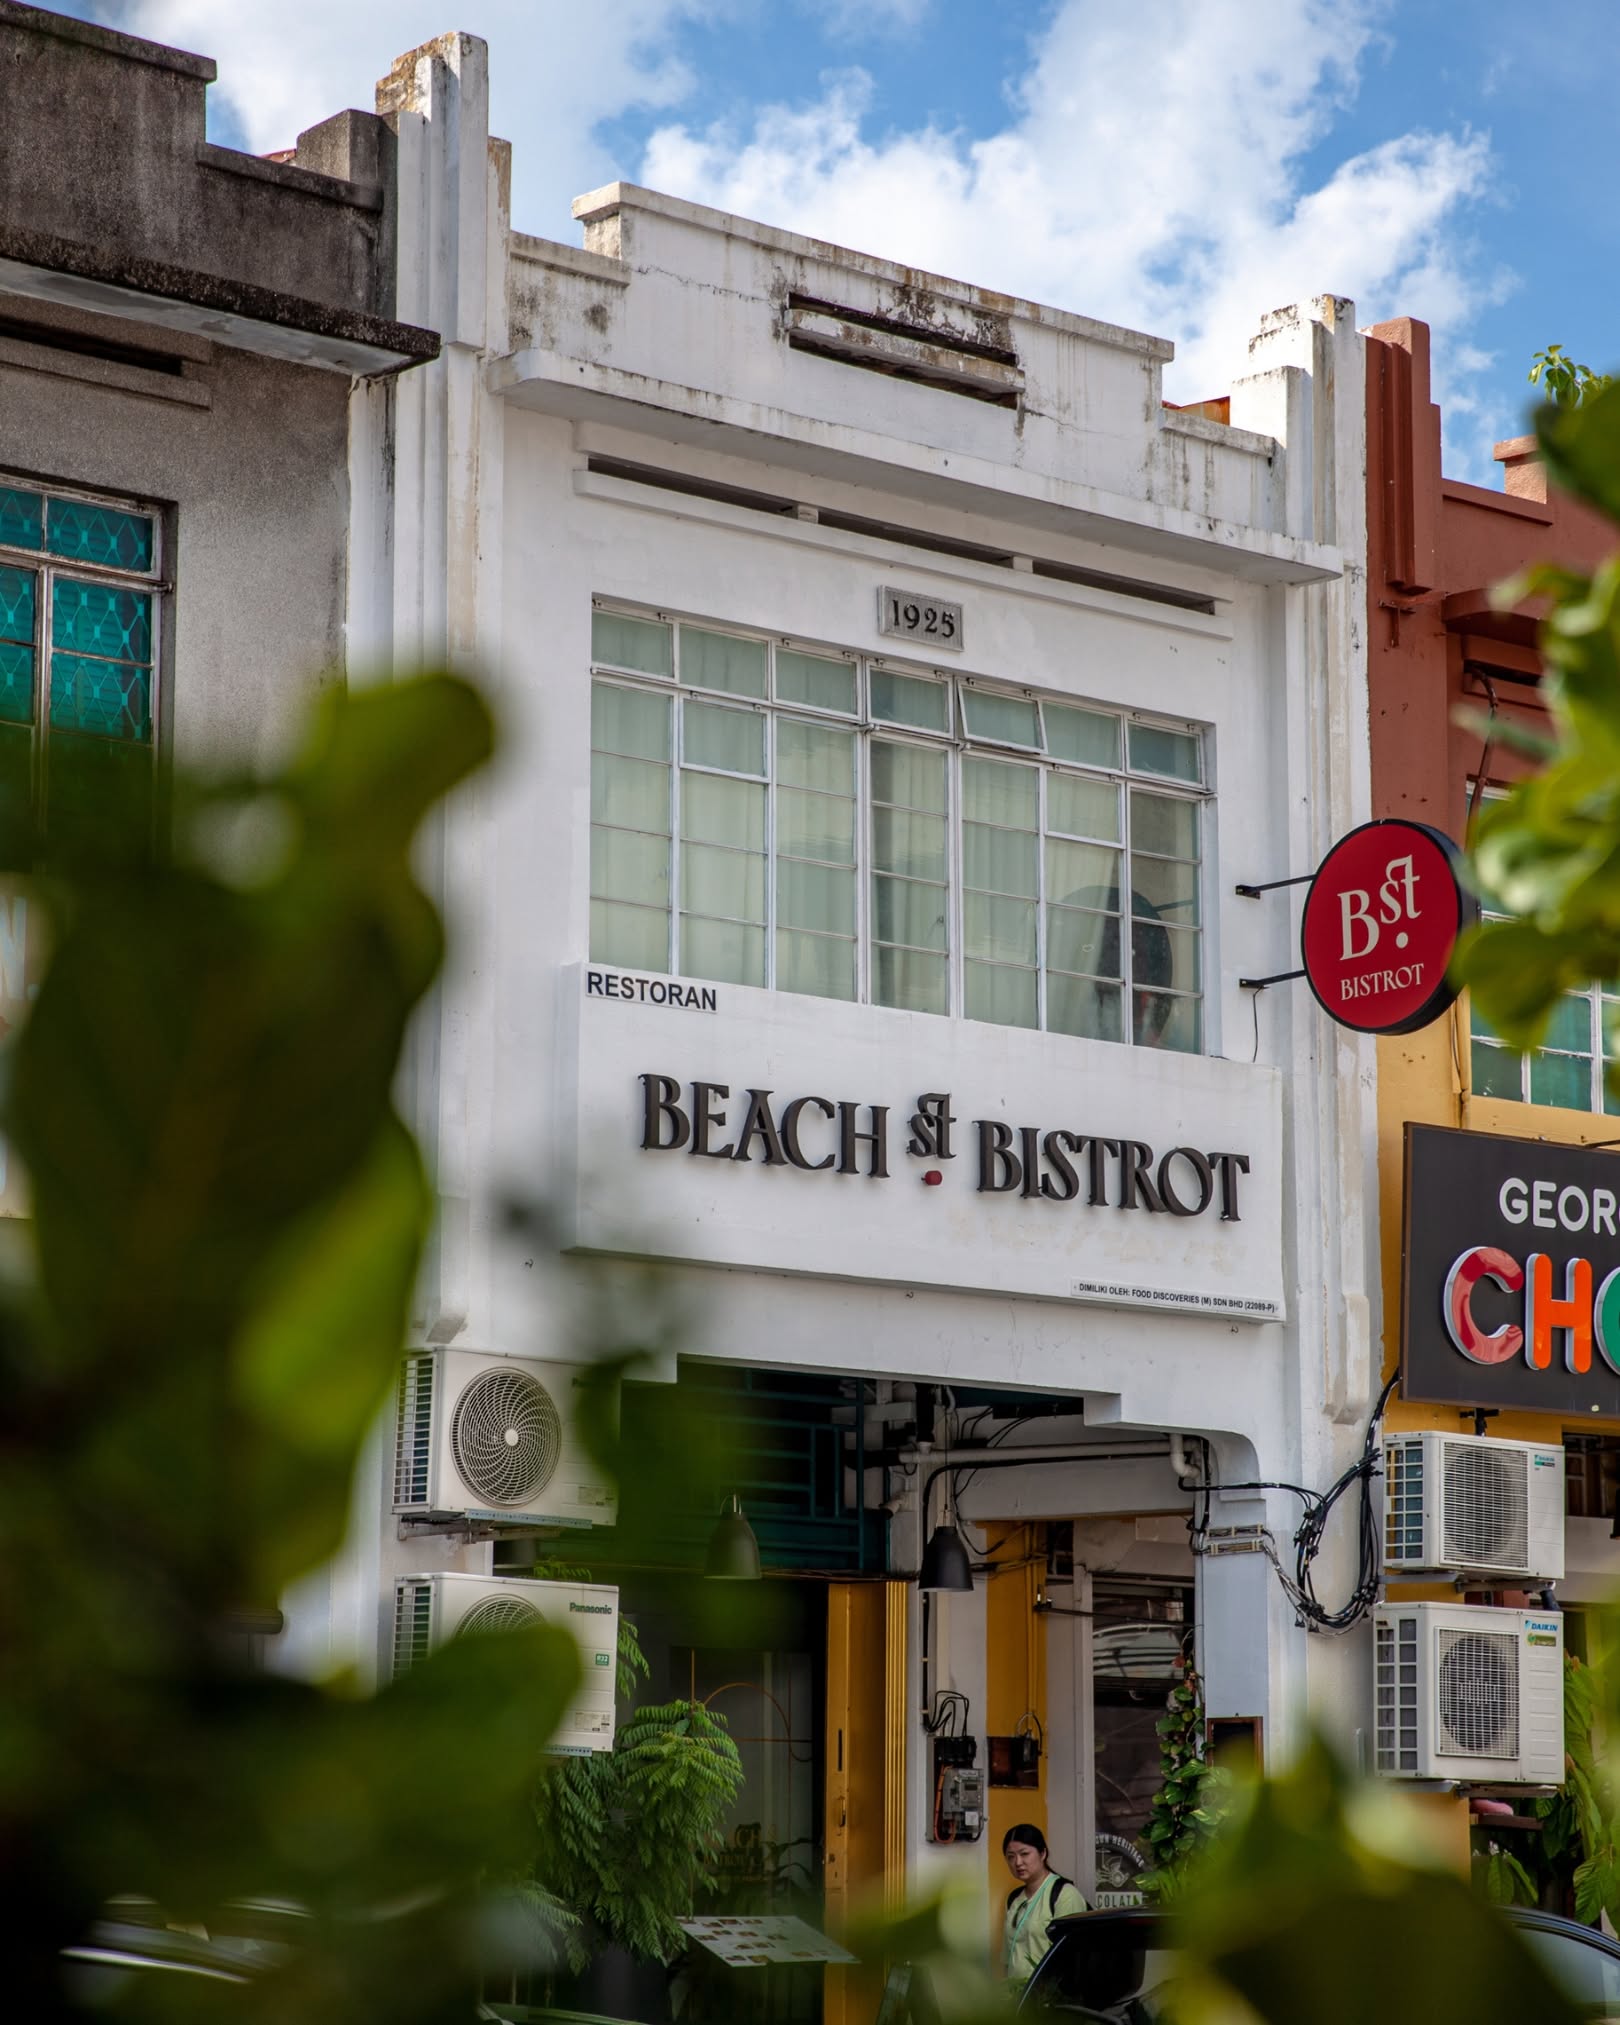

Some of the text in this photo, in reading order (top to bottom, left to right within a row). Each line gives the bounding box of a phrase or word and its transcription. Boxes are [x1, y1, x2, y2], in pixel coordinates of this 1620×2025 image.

[892, 599, 955, 638] 1925
[587, 971, 717, 1011] RESTORAN
[1341, 963, 1424, 1001] BISTROT
[638, 1073, 890, 1178] BEACH
[972, 1120, 1250, 1222] BISTROT
[1499, 1177, 1620, 1236] GEOR
[1079, 1283, 1108, 1294] DIMILIKI
[1109, 1286, 1131, 1296] OLEH:
[1132, 1289, 1151, 1299] FOOD
[1153, 1291, 1200, 1304] DISCOVERIES
[1201, 1296, 1212, 1306] (M)
[1213, 1297, 1227, 1307] SDN
[1228, 1299, 1243, 1309] BHD
[569, 1602, 612, 1615] Panasonic
[1531, 1622, 1557, 1632] DAIKIN
